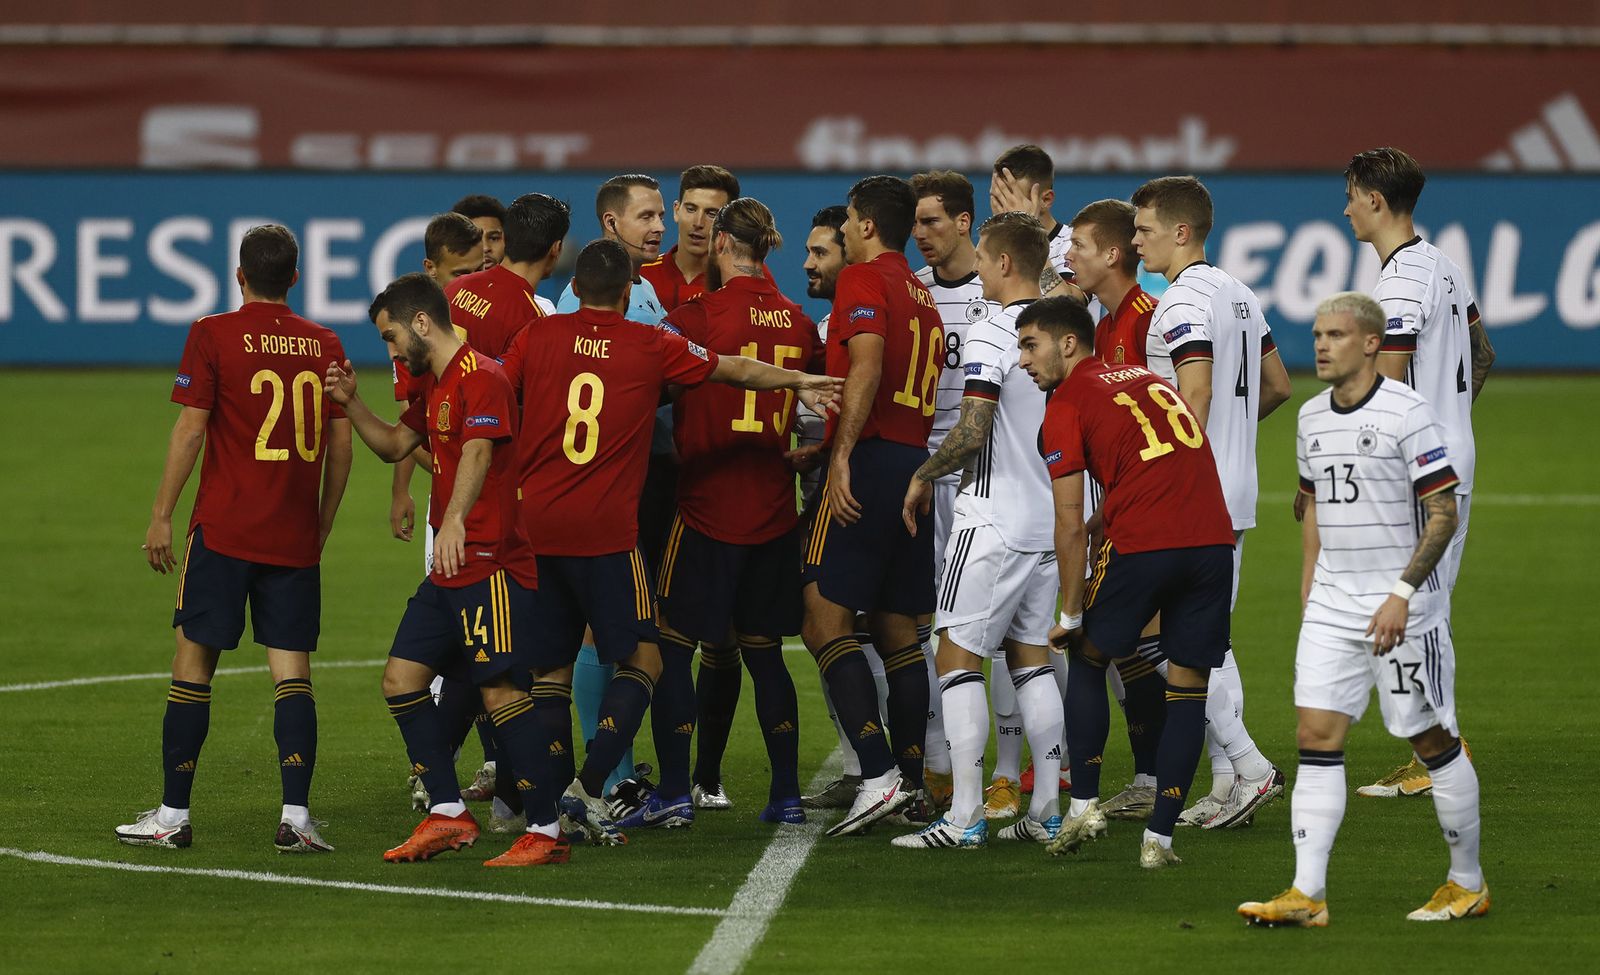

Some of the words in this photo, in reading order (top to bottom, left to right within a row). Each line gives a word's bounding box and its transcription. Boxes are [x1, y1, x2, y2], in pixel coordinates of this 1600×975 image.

[0, 217, 430, 322] RESEC
[452, 288, 492, 319] MORATA
[750, 306, 792, 328] RAMOS
[243, 333, 257, 353] S.
[261, 334, 321, 358] ROBERTO
[574, 335, 611, 358] KOKE
[893, 317, 943, 416] 16
[1098, 367, 1152, 384] FERRAN
[1235, 331, 1249, 419] 4
[731, 341, 802, 436] 15
[250, 369, 322, 462] 20
[475, 416, 499, 425] RESPECT
[563, 372, 605, 465] 8
[1112, 383, 1203, 462] 18
[1324, 463, 1359, 504] 13
[460, 605, 488, 646] 14
[1389, 658, 1425, 694] 13
[999, 725, 1022, 737] DFB
